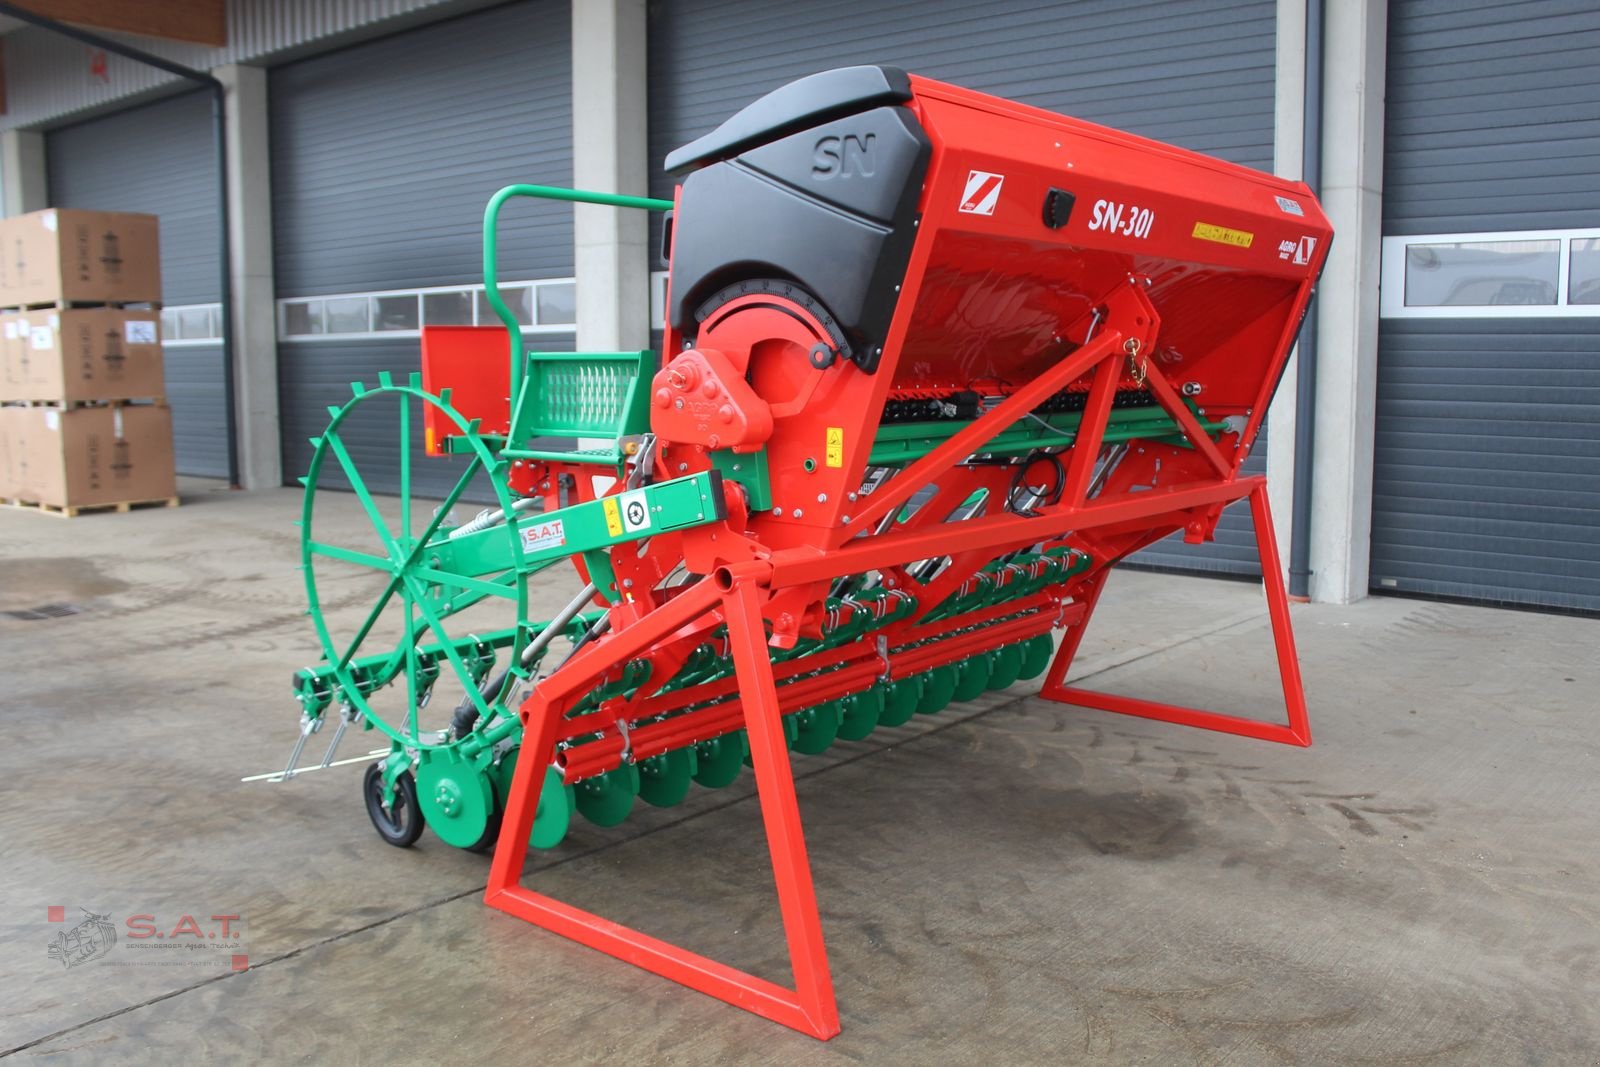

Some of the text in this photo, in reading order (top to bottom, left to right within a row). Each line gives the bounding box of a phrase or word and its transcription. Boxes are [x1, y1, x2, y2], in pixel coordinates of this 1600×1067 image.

[812, 132, 876, 180] SN
[1088, 199, 1155, 239] SN-301
[527, 522, 563, 541] S.A.T.
